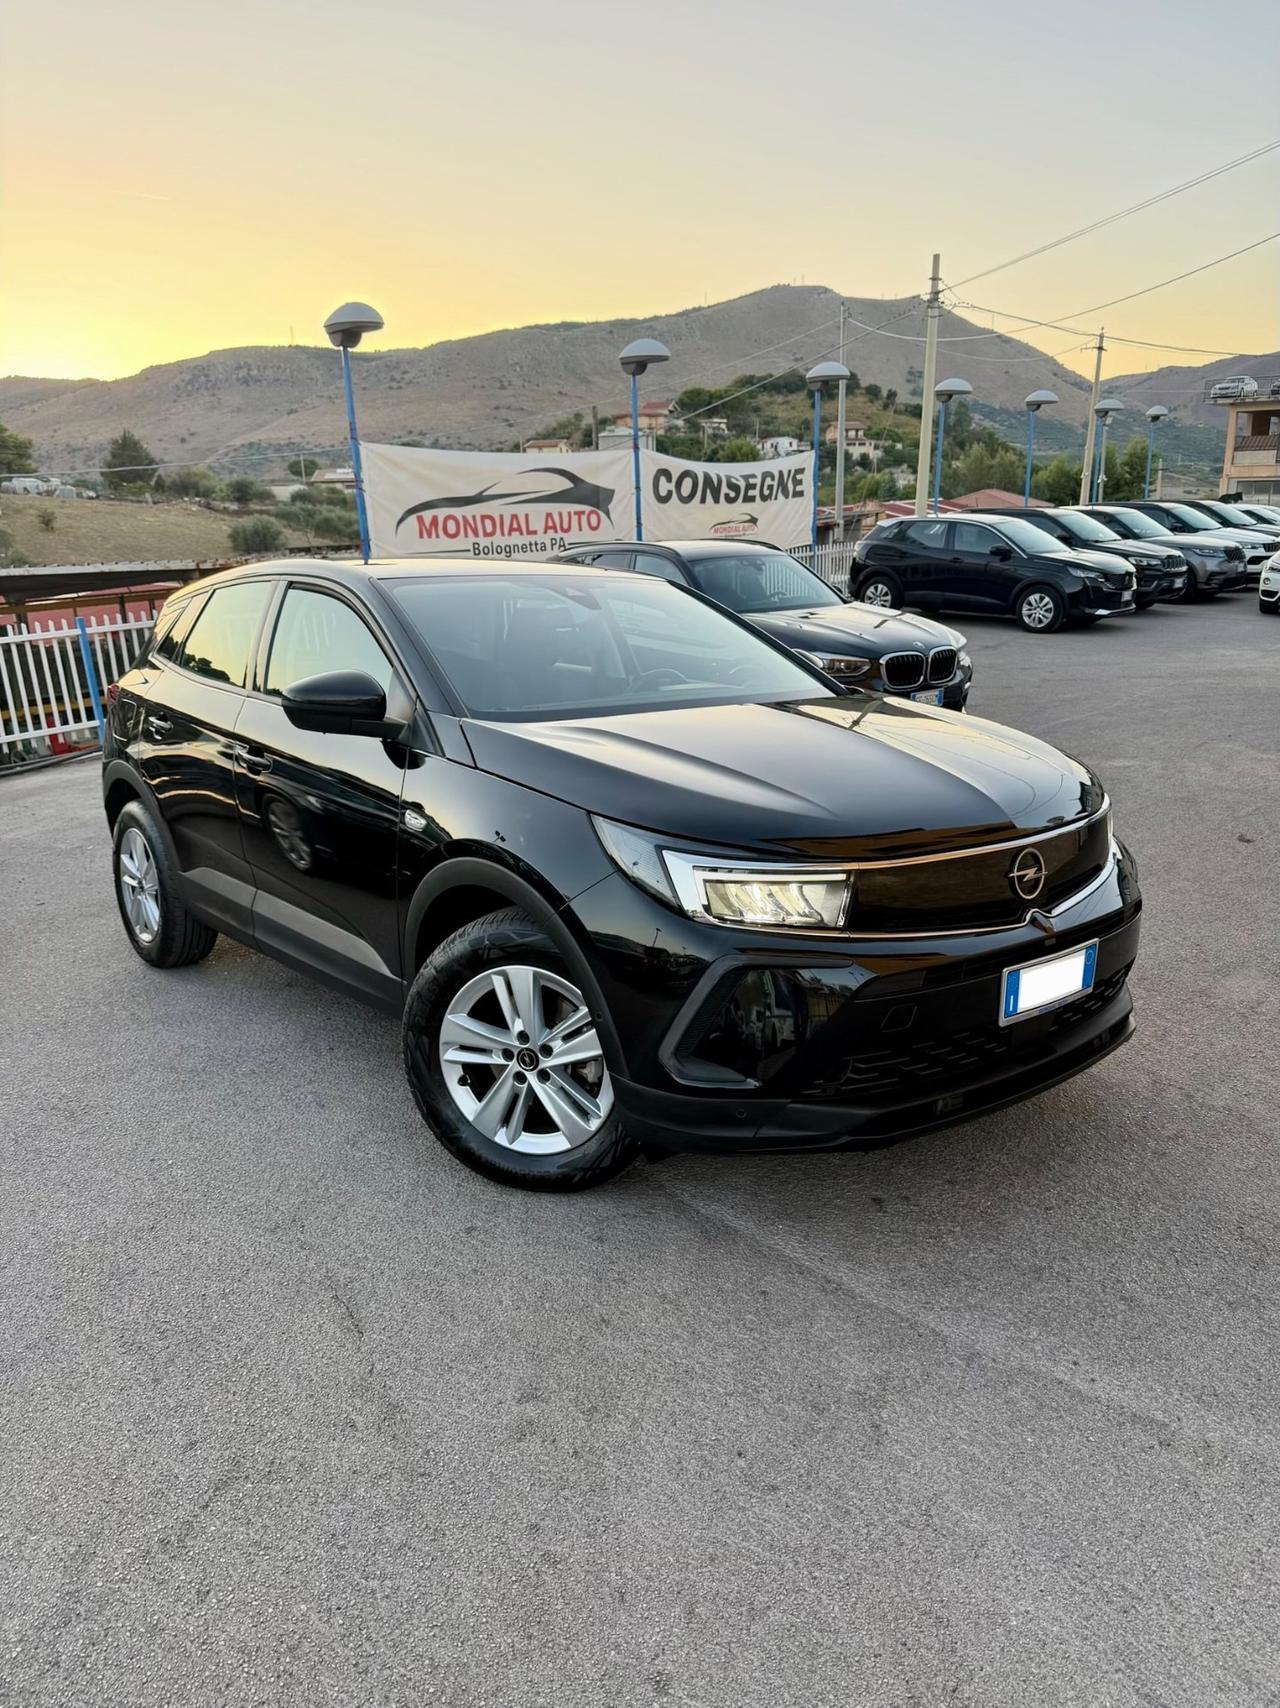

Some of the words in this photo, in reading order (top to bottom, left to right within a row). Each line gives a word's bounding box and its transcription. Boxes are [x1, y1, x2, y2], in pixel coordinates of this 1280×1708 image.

[652, 467, 806, 505] CONSEGNE
[416, 513, 538, 539] MONDIAL
[543, 509, 602, 534] AUTO
[472, 541, 547, 558] Bolognetta
[550, 537, 567, 551] PA
